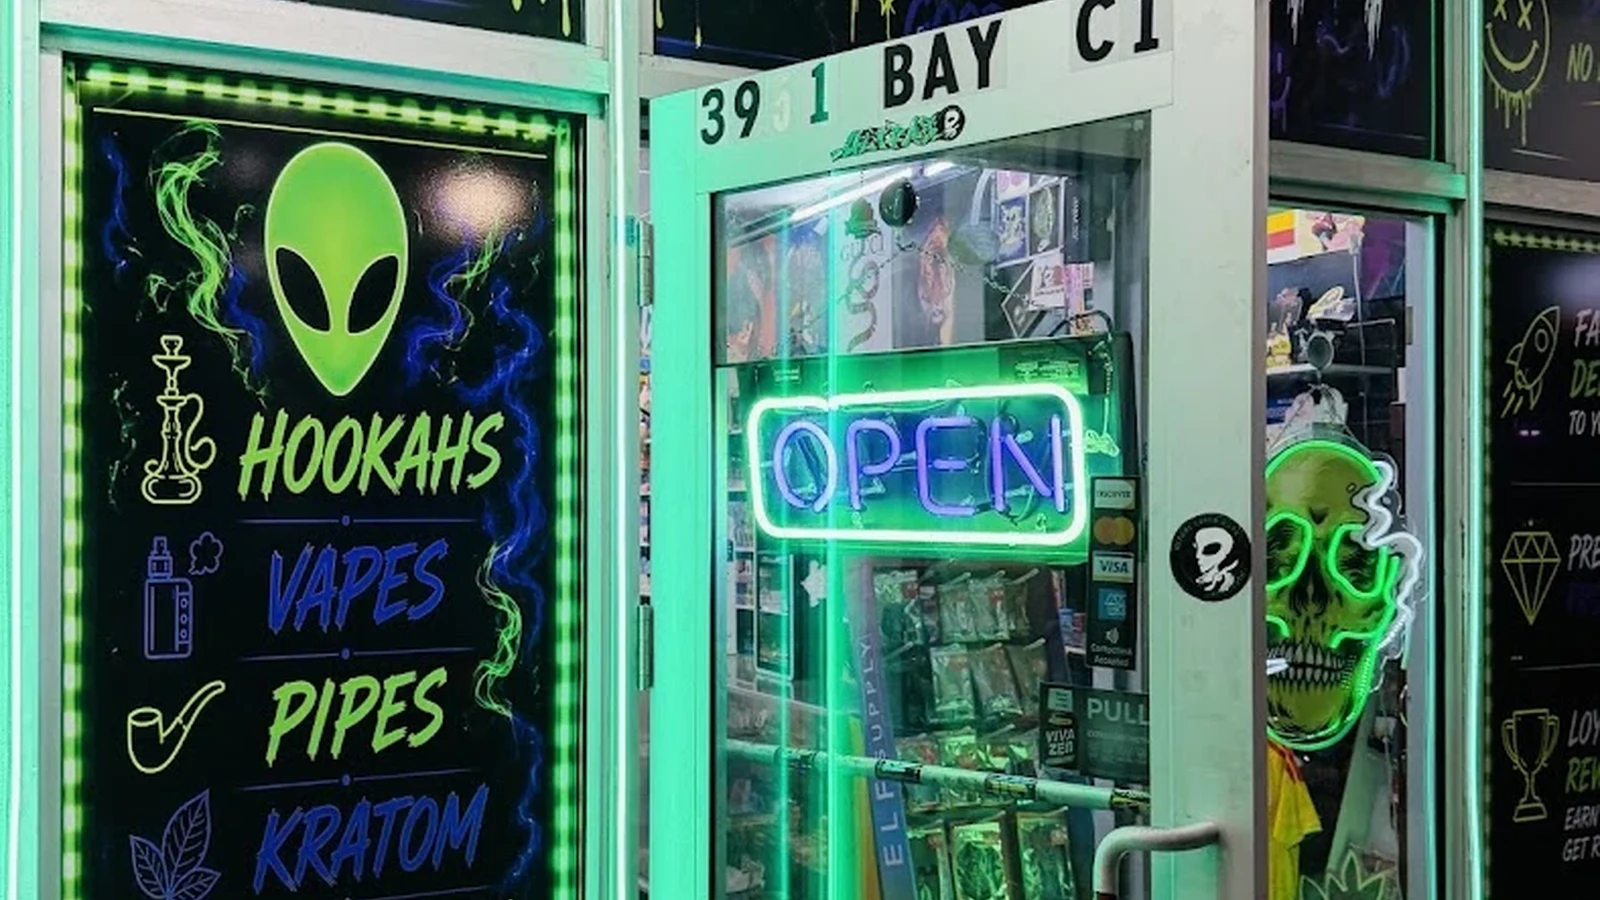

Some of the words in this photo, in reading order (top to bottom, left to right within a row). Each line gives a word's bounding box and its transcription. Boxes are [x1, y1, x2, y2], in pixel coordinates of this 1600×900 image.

[884, 20, 1002, 109] BAY
[1567, 42, 1594, 82] NO
[1568, 409, 1587, 436] TO
[237, 410, 505, 501] HOOKAHS
[773, 415, 1068, 516] OPEN
[267, 538, 449, 633] VAPES
[1099, 560, 1130, 574] VISA
[265, 667, 448, 767] PIPES
[1086, 697, 1150, 726] PULL
[1045, 728, 1075, 744] VIVA
[1563, 804, 1600, 832] EARN
[253, 784, 490, 894] KRATOM
[1562, 836, 1590, 863] GET
